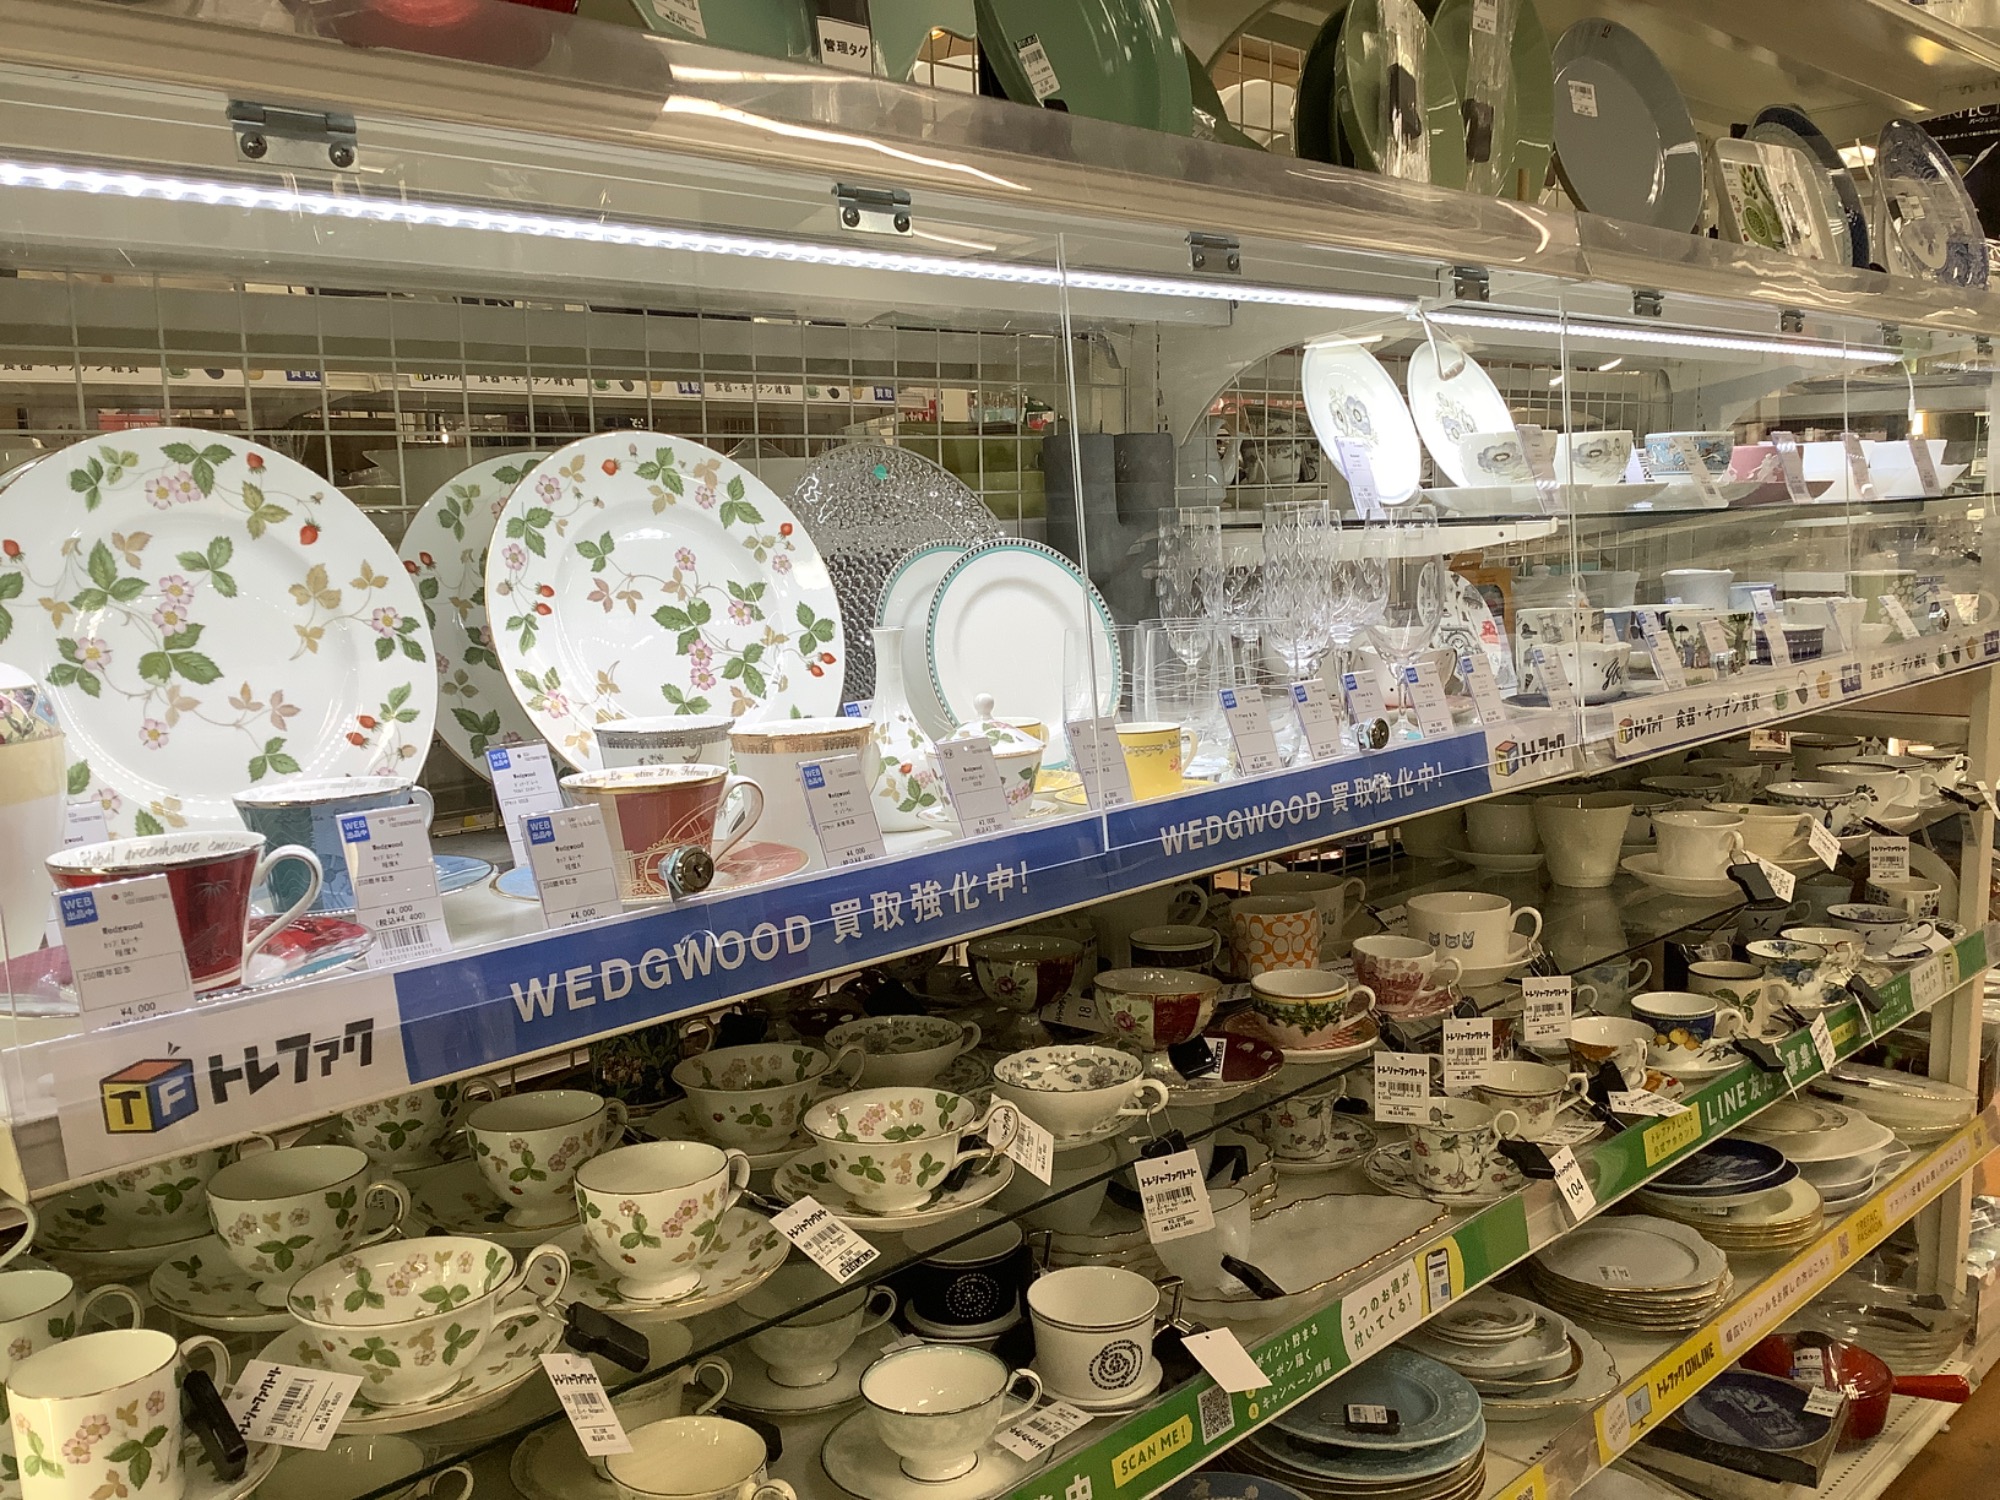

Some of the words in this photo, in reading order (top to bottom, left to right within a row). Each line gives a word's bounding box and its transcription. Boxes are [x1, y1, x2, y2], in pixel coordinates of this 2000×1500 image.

[823, 37, 869, 58] 管理タグ
[1522, 733, 1565, 767] トレファク
[1160, 791, 1321, 857] WEDGWOOD
[1331, 760, 1446, 816] 買取強化中!
[343, 820, 366, 831] WEB
[529, 820, 551, 831] WEB
[124, 841, 201, 862] greenhouse
[63, 895, 93, 911] WEB
[386, 904, 413, 916] ¥4,000
[66, 908, 95, 922] 出品中
[375, 912, 426, 928] (税込¥4,400)
[570, 907, 597, 920] ¥4,000
[101, 920, 145, 936] Wedgwood
[510, 913, 813, 1024] WEDGWOOD
[829, 858, 1029, 944] 買取強化中!
[1525, 988, 1570, 998] トレジャーファクトリー
[120, 1001, 157, 1017] ¥4,000
[1078, 1005, 1092, 1019] 18
[1445, 1031, 1491, 1042] トレジャーファクトリー
[208, 1017, 374, 1105] トレファク
[1377, 1065, 1428, 1077] トレジャーファクトリー
[1140, 1167, 1197, 1188] トレジャーファクトリー
[1565, 1177, 1584, 1201] 104
[786, 1208, 828, 1240] トレジャーファクトリー
[1347, 1267, 1411, 1331] 3つのお得が
[1353, 1291, 1413, 1351] 付いてくる!
[552, 1372, 598, 1386] トレジャーファクトリー
[1261, 1357, 1332, 1410] キャンペーン情報
[239, 1366, 282, 1436] トレジャーファクトリー
[1120, 1444, 1157, 1476] SCAN
